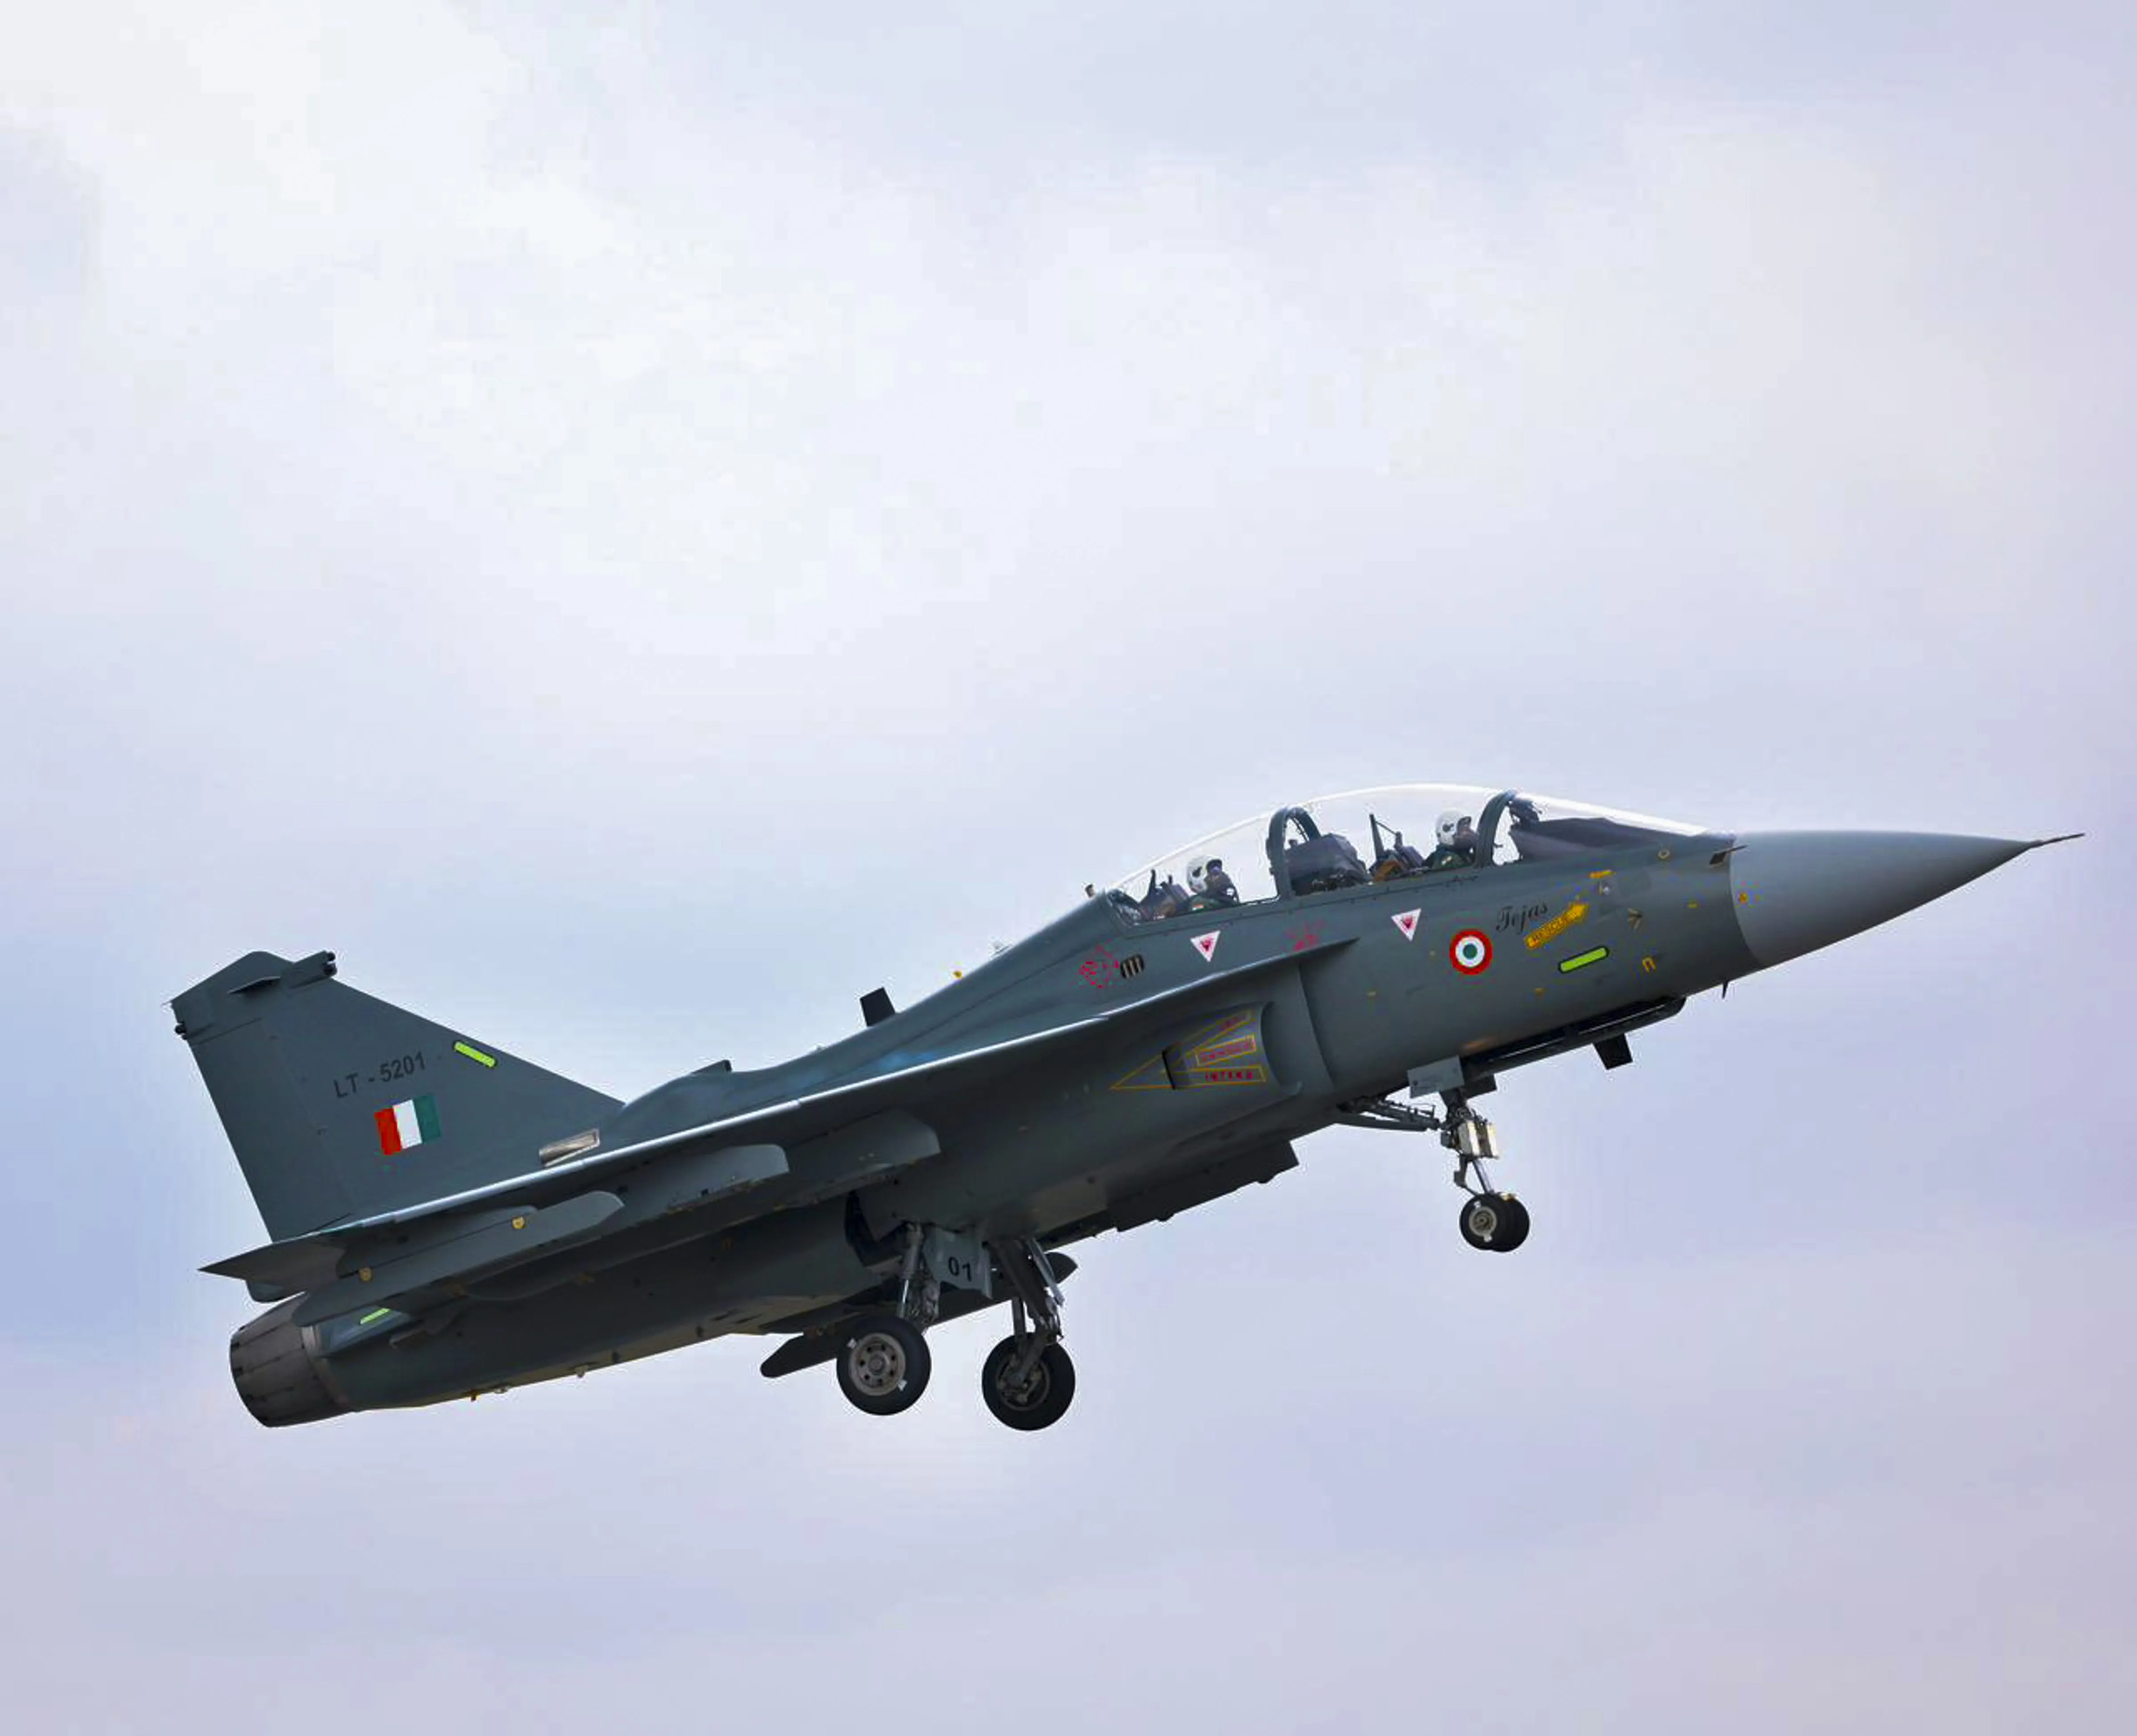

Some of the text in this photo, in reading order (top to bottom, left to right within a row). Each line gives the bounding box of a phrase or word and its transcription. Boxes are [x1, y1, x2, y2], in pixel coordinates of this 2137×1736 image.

[1496, 901, 1548, 934] Tejas
[333, 1072, 358, 1098] LT
[379, 1051, 426, 1082] 5201
[948, 1256, 972, 1282] 01
